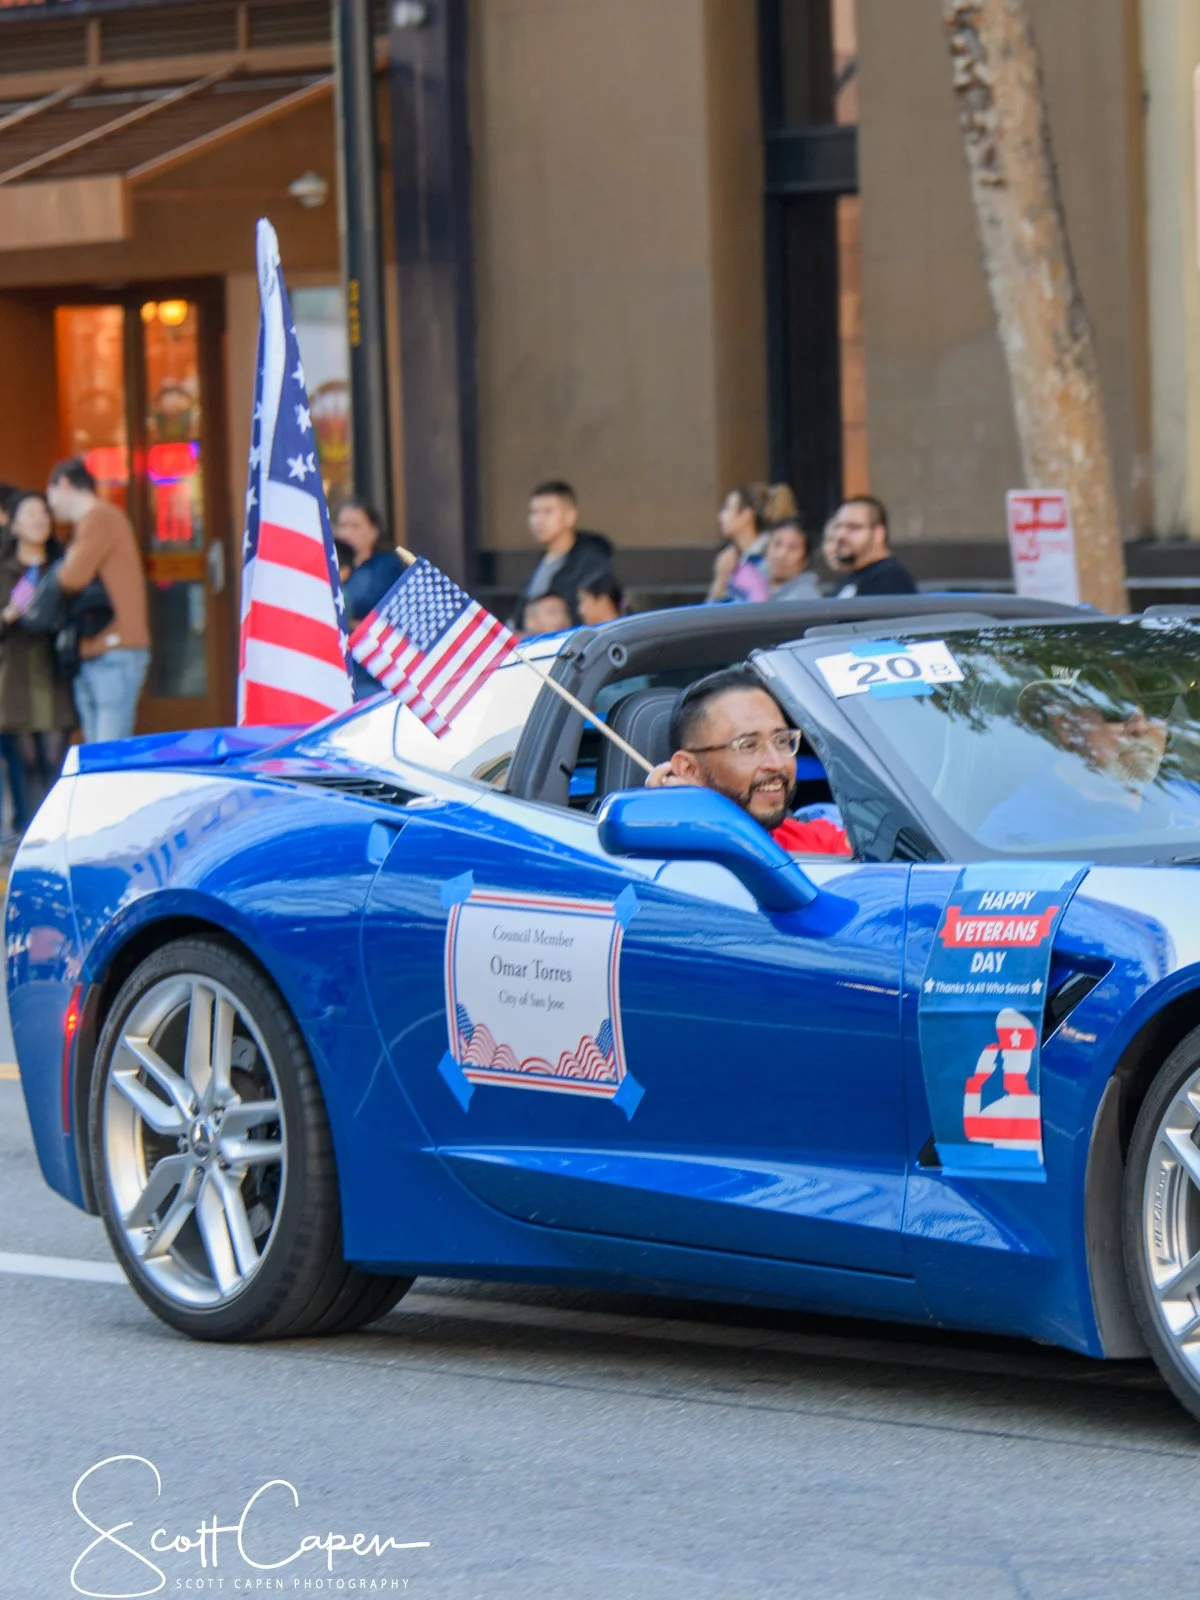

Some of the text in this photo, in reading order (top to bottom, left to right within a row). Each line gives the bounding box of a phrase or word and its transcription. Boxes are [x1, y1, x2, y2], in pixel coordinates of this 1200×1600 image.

[849, 656, 922, 686] 20
[977, 890, 1037, 911] HAPPY
[492, 924, 575, 947] Council Member
[954, 920, 1040, 942] VETERANS
[490, 954, 573, 982] Omar Torres
[970, 951, 1007, 973] DAY
[936, 981, 965, 994] Thanks
[965, 982, 975, 994] To
[986, 981, 1005, 994] Who
[498, 989, 518, 1009] City
